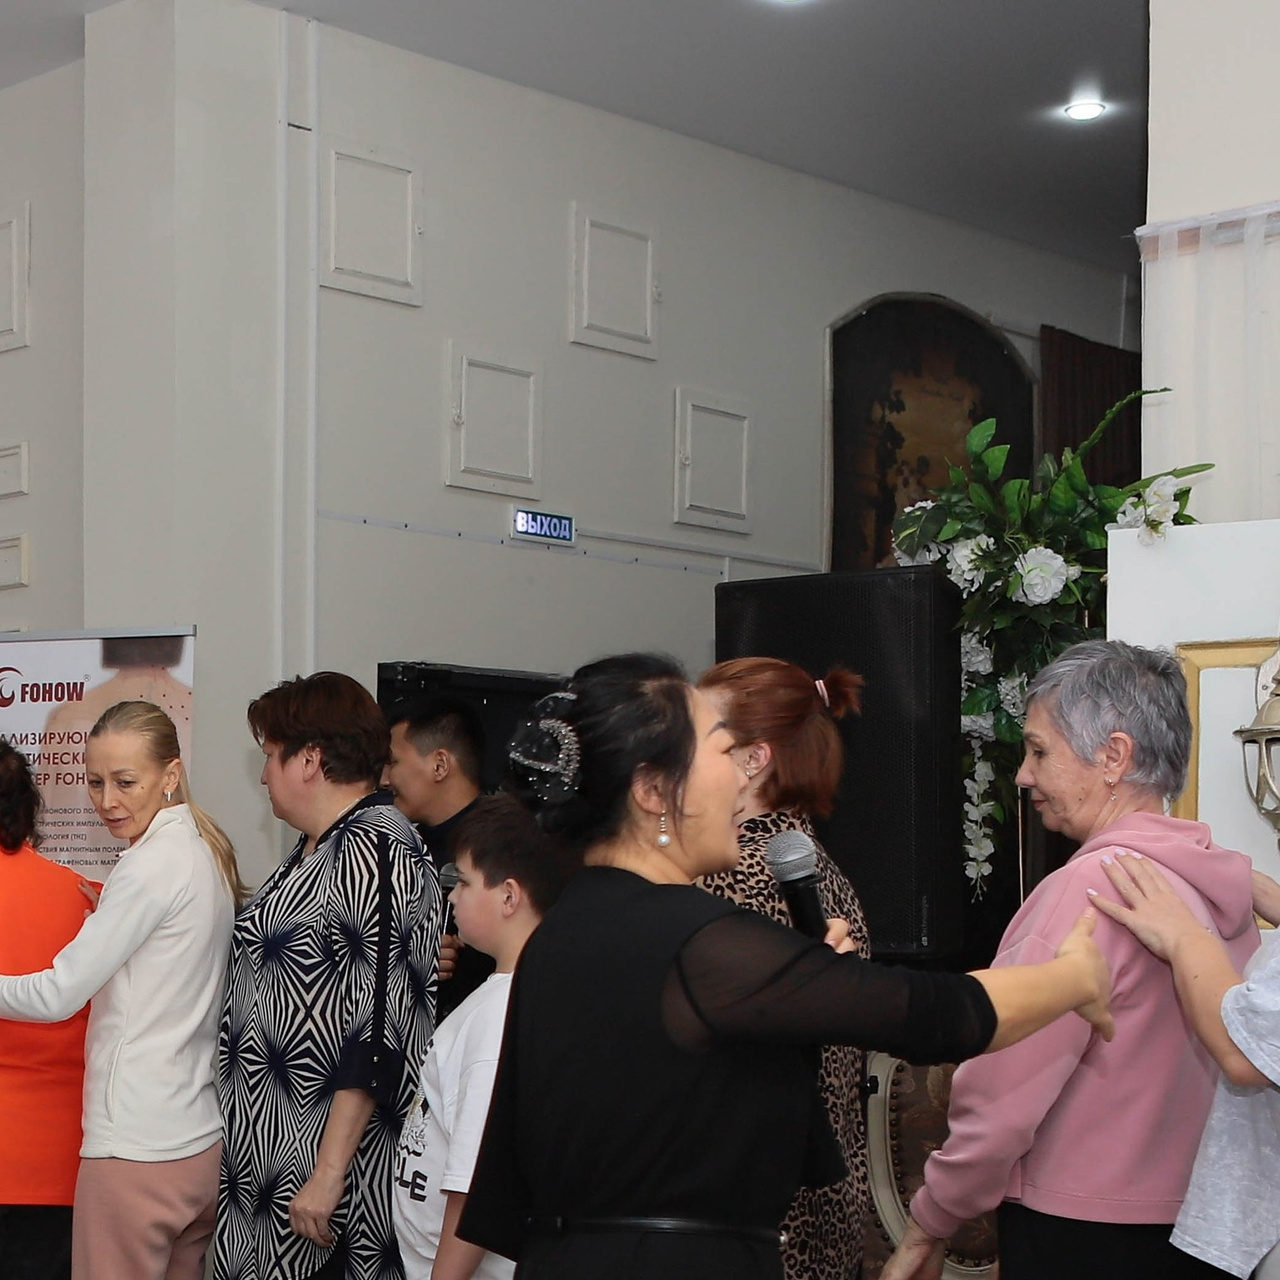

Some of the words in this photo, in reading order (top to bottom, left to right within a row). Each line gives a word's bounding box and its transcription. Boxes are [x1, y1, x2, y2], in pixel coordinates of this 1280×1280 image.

[516, 511, 570, 539] ВЫХОД
[20, 682, 85, 702] FOHOW
[35, 773, 50, 786] ЕР
[55, 773, 86, 786] FOH
